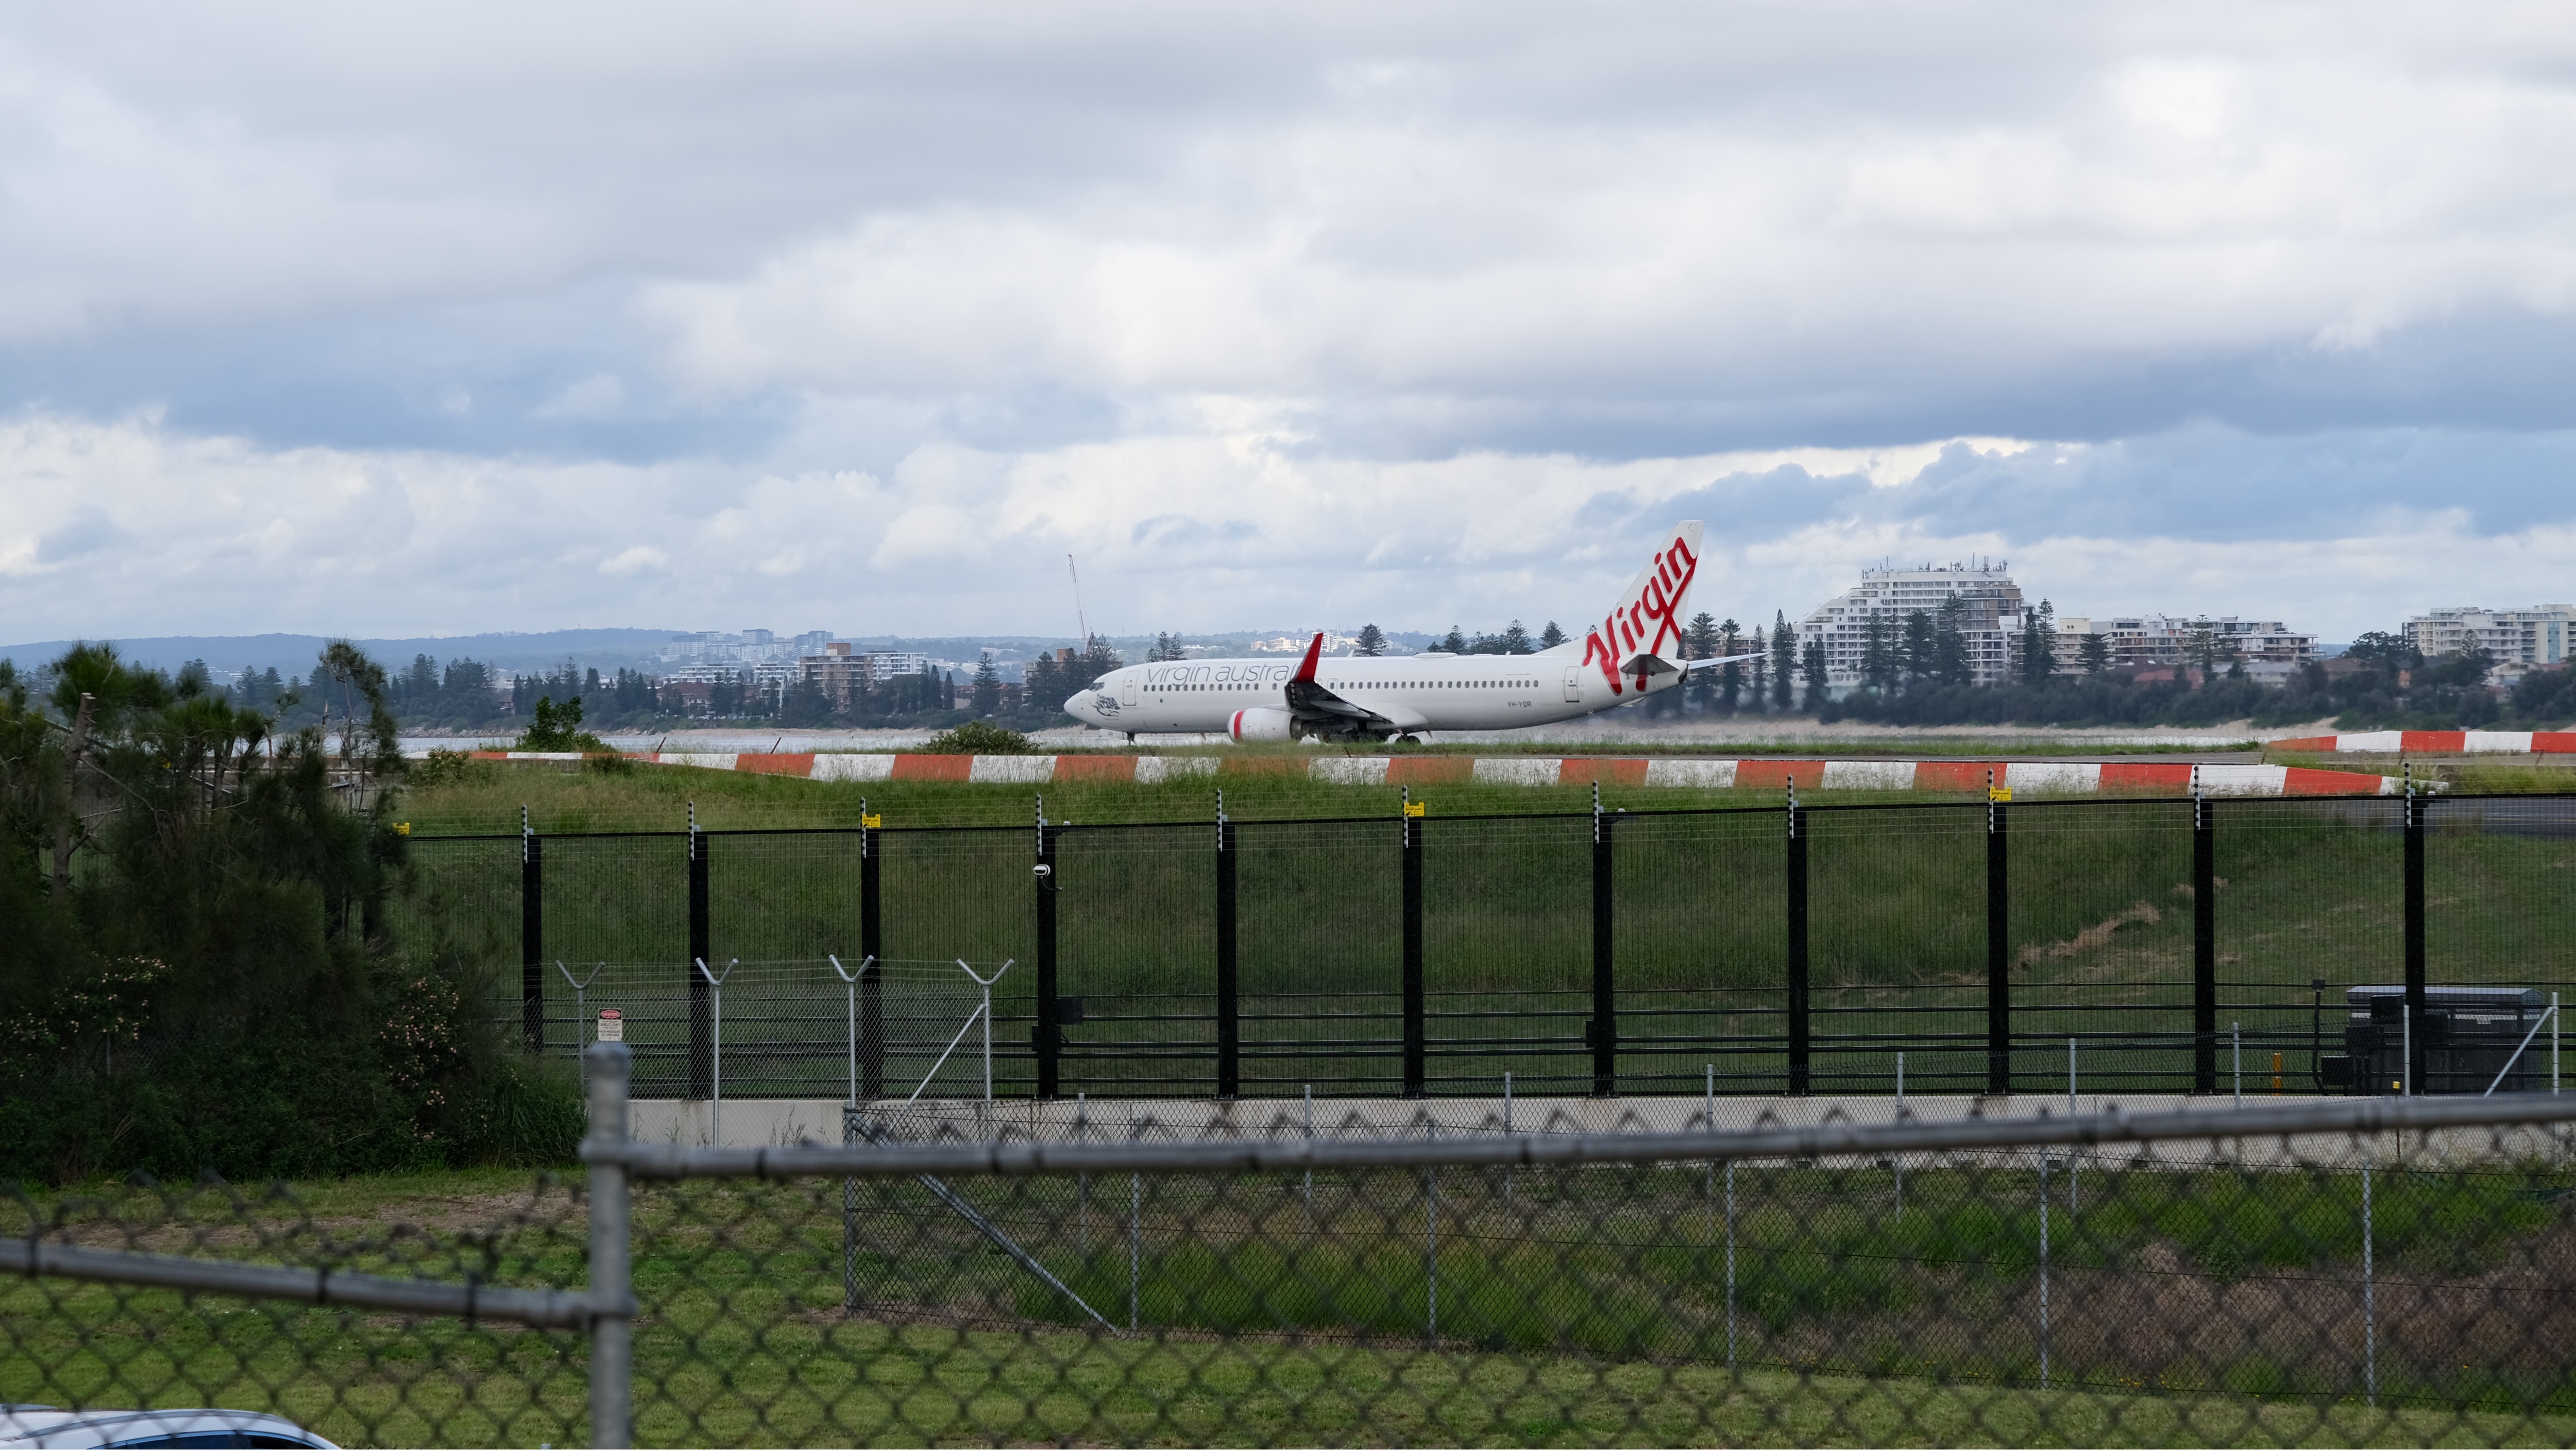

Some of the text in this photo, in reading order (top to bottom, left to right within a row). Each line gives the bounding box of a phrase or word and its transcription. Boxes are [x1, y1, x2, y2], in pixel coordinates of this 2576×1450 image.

[1582, 537, 1698, 695] Virgin
[1148, 662, 1297, 687] virgin austral
